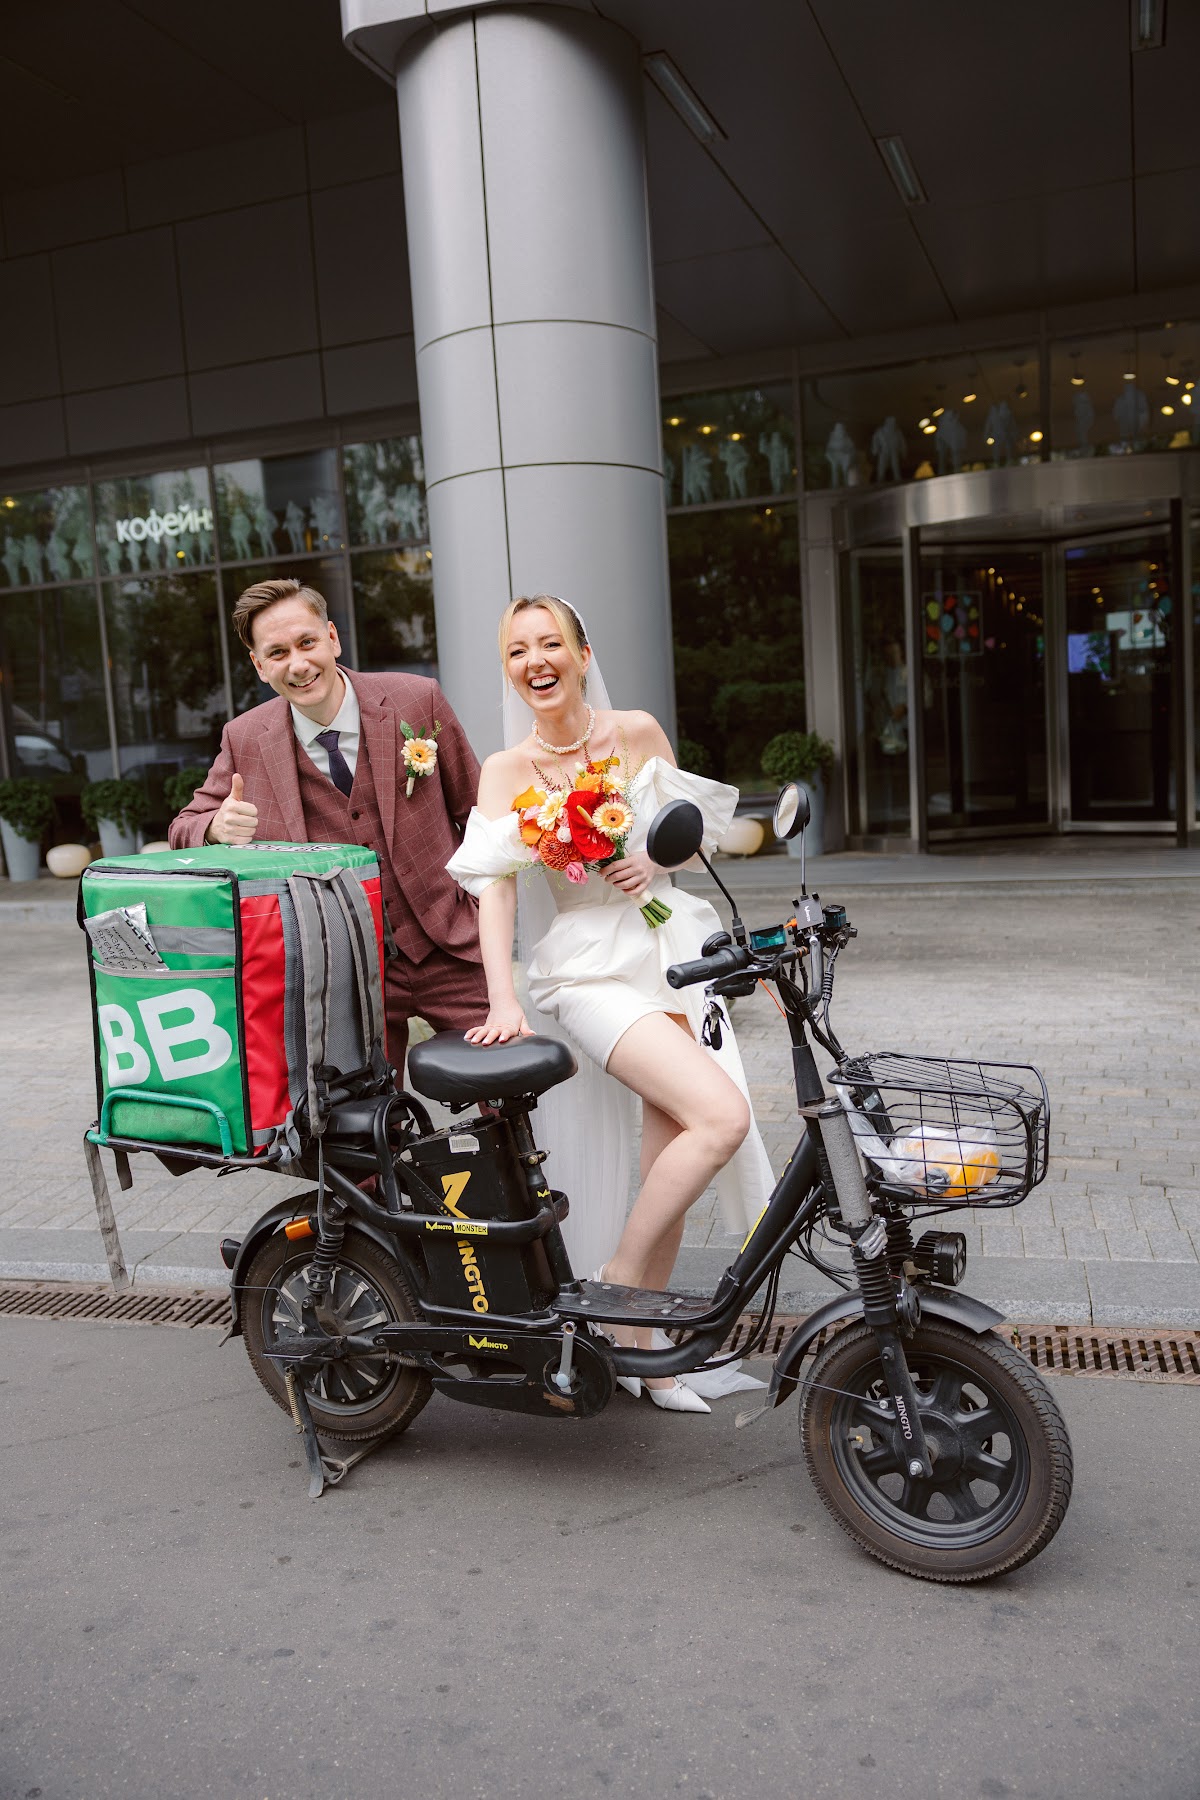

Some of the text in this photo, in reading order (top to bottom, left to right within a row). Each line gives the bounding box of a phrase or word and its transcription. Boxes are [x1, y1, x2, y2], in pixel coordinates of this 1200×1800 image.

[115, 504, 214, 544] кофейн
[456, 1224, 487, 1233] MONSTER
[468, 1334, 509, 1350] MINGTO
[894, 1395, 913, 1440] MINGTO
